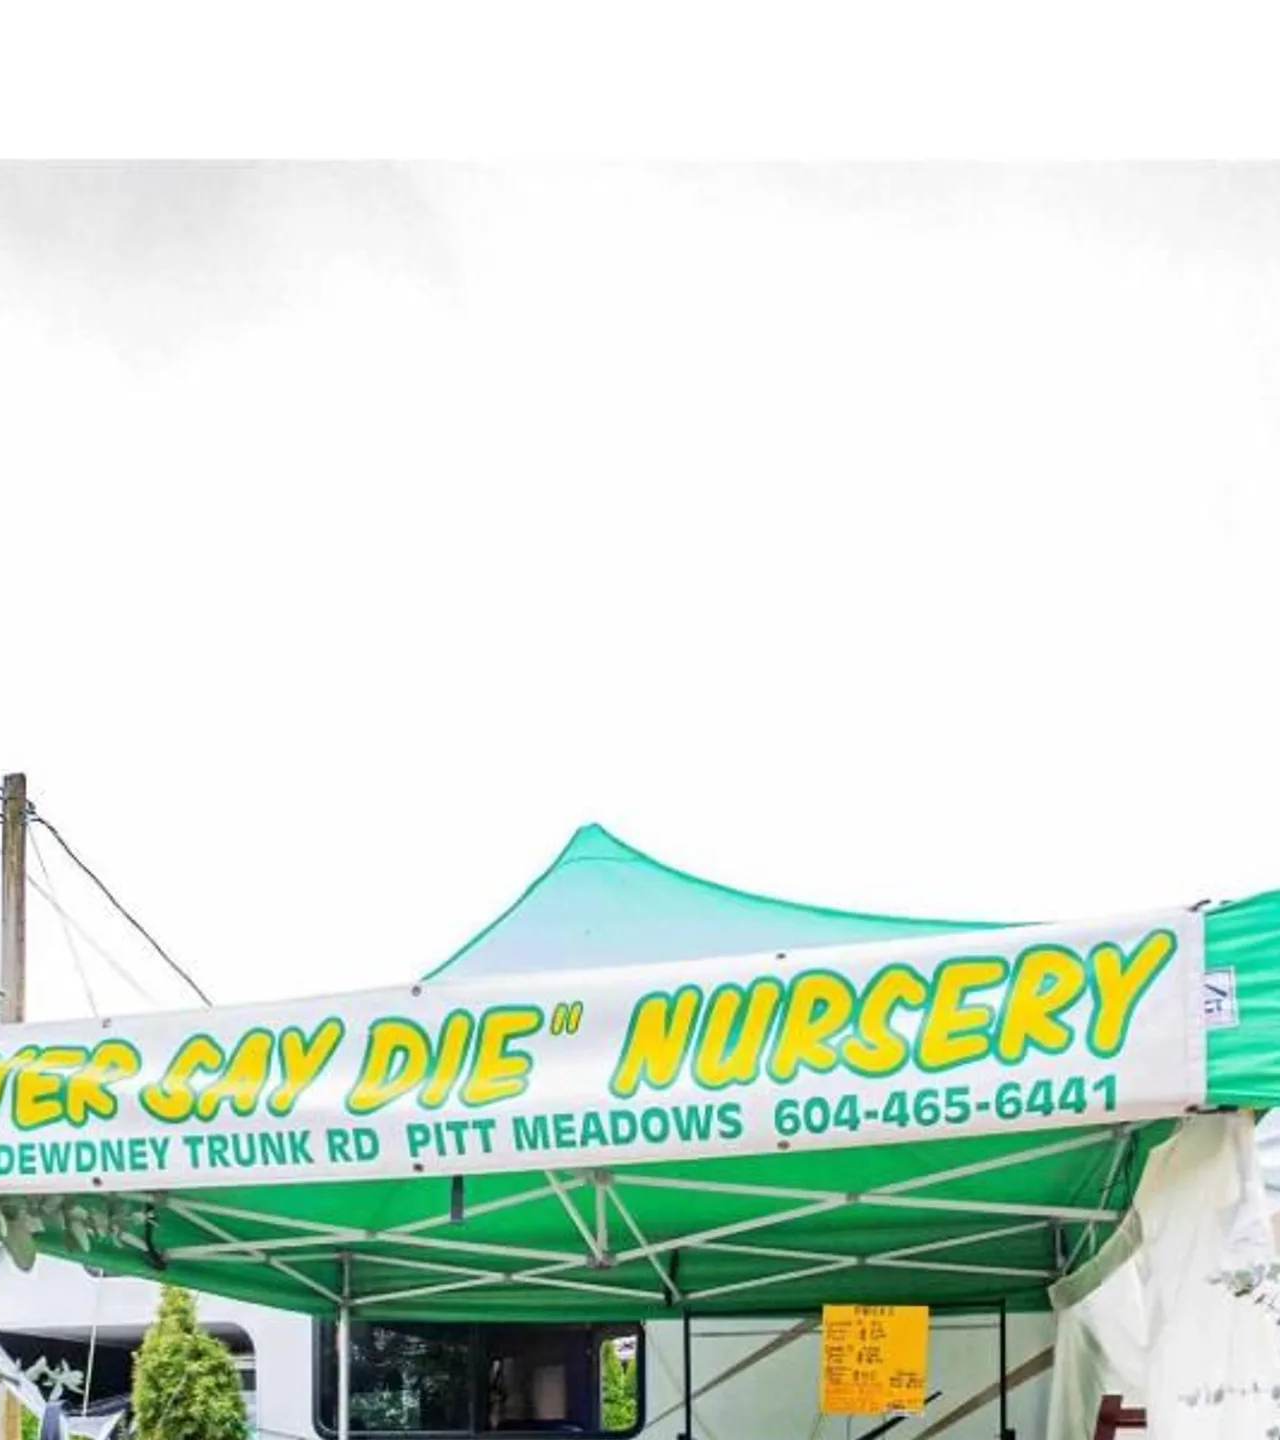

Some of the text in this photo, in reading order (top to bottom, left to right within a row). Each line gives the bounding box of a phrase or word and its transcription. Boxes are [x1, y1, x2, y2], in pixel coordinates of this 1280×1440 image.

[140, 1016, 343, 1125] SAY
[610, 930, 1177, 1098] NURSERY
[185, 1129, 313, 1168] TRUNK
[327, 1127, 380, 1163] RD
[406, 1117, 496, 1158] PITT
[512, 1103, 743, 1152] MEADOWS
[773, 1075, 1119, 1137] 604-465-6441
